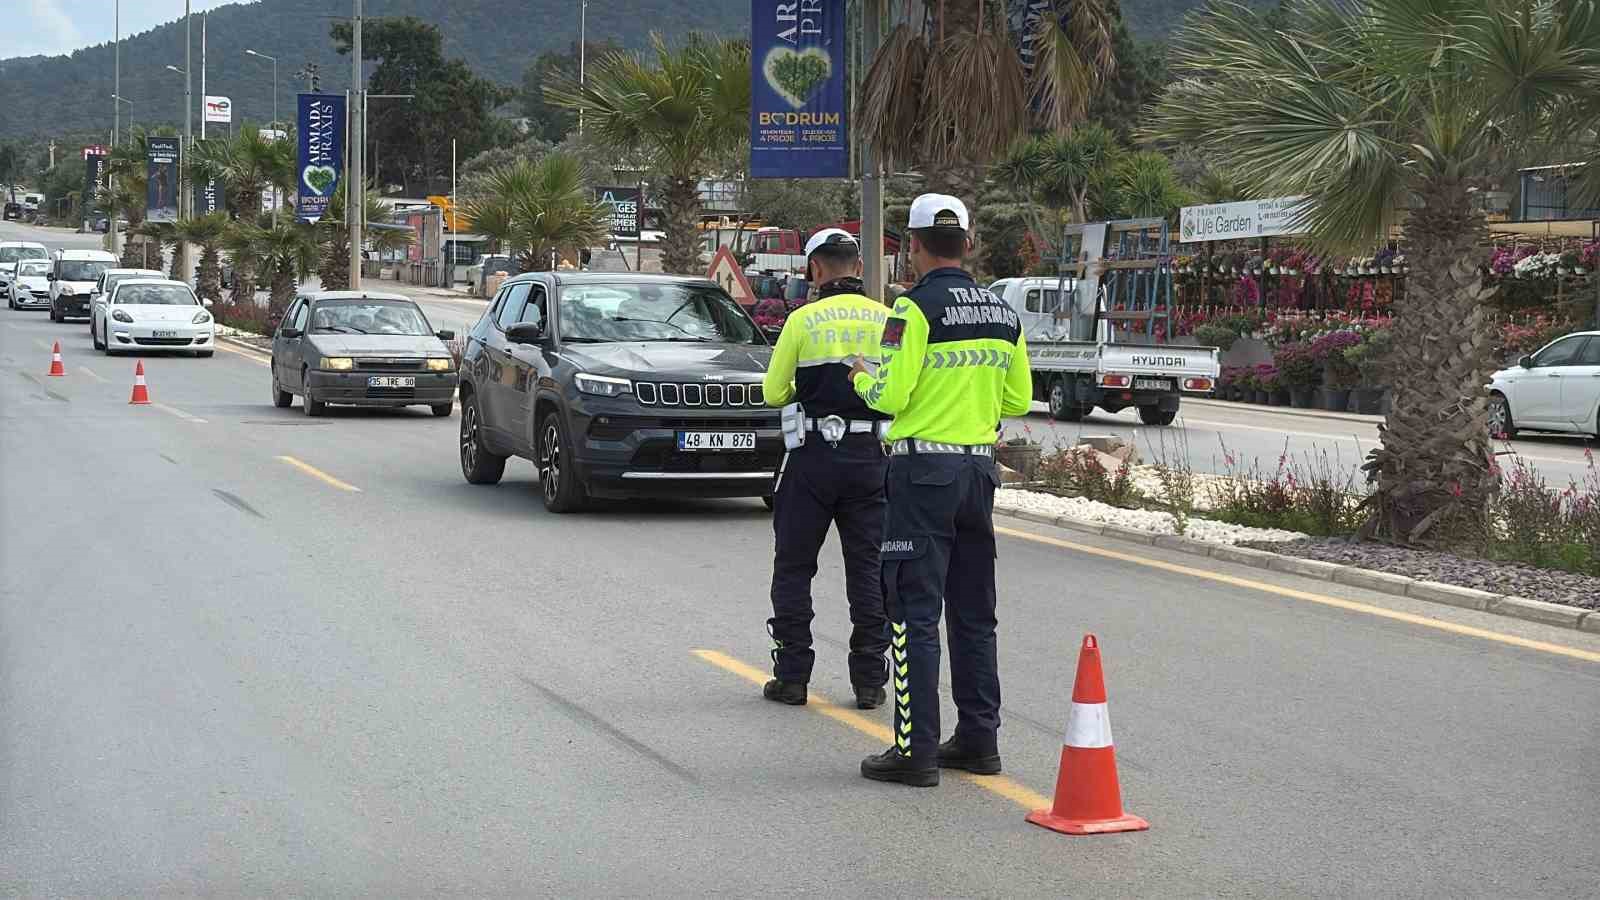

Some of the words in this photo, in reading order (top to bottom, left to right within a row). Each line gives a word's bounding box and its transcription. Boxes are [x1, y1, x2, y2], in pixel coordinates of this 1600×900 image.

[309, 100, 320, 166] ARMADA
[321, 104, 333, 161] PRAXIS
[1215, 215, 1251, 233] Garden
[805, 307, 886, 330] JANDARM
[942, 305, 1018, 330] JANDARMASI
[1132, 355, 1186, 367] HYUNDAI
[372, 377, 380, 385] 35
[404, 378, 413, 386] 90
[686, 433, 701, 447] 48
[709, 433, 724, 447] KN
[732, 433, 753, 447] 876
